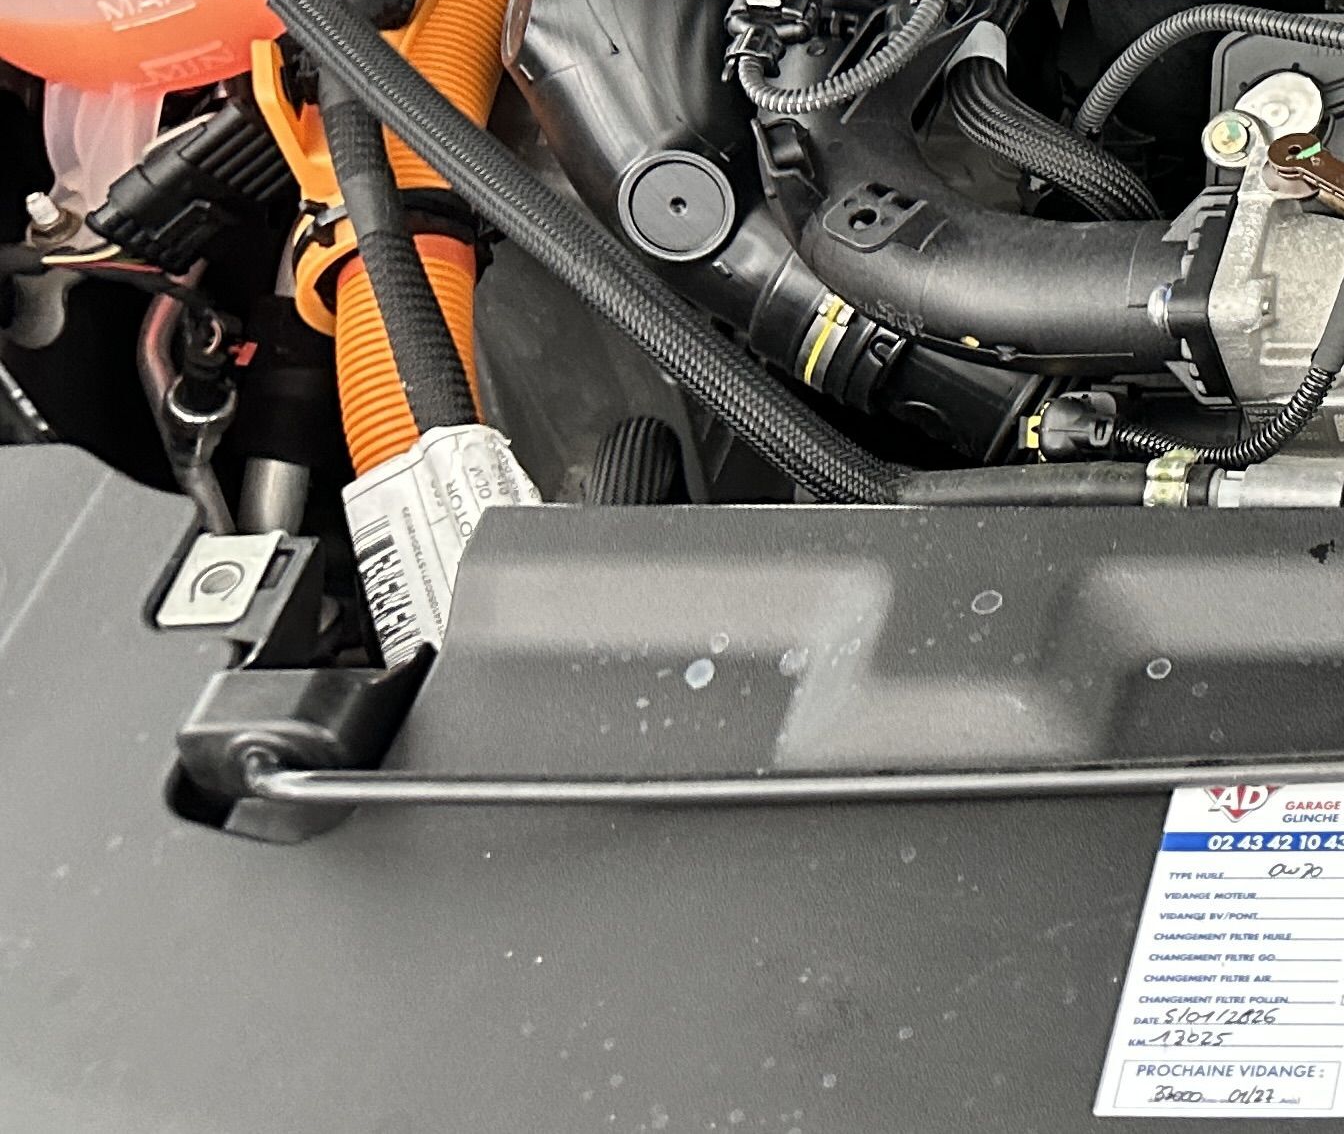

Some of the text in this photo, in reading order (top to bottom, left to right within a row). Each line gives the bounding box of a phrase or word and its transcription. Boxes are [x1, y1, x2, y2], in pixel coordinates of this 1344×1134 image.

[446, 478, 475, 538] OTOR
[1209, 785, 1269, 812] AD
[1285, 800, 1341, 810] GARAGE
[1282, 813, 1340, 823] GLINCHE
[1208, 834, 1234, 850] 02
[1237, 834, 1264, 850] 43
[1267, 834, 1294, 850] 42
[1299, 834, 1321, 850] 10
[1168, 870, 1224, 880] TYPE HUILE
[1164, 891, 1257, 900] VIDANGE MOTEUR
[1159, 912, 1259, 921] VIDANGE BV/PONT
[1153, 932, 1292, 941] CHANGEMENT FILTRE HUILE
[1149, 953, 1276, 962] CHANGEMENT FILTRE GO
[1143, 974, 1271, 983] CHANGEMENT FILTRE AIR
[1138, 995, 1288, 1004] CHANGEMENT FILTRE POLLEN
[1133, 1017, 1159, 1025] DATE
[1128, 1039, 1145, 1047] KM
[1136, 1064, 1235, 1077] PROCHAINE
[1240, 1064, 1316, 1077] VIDANGE
